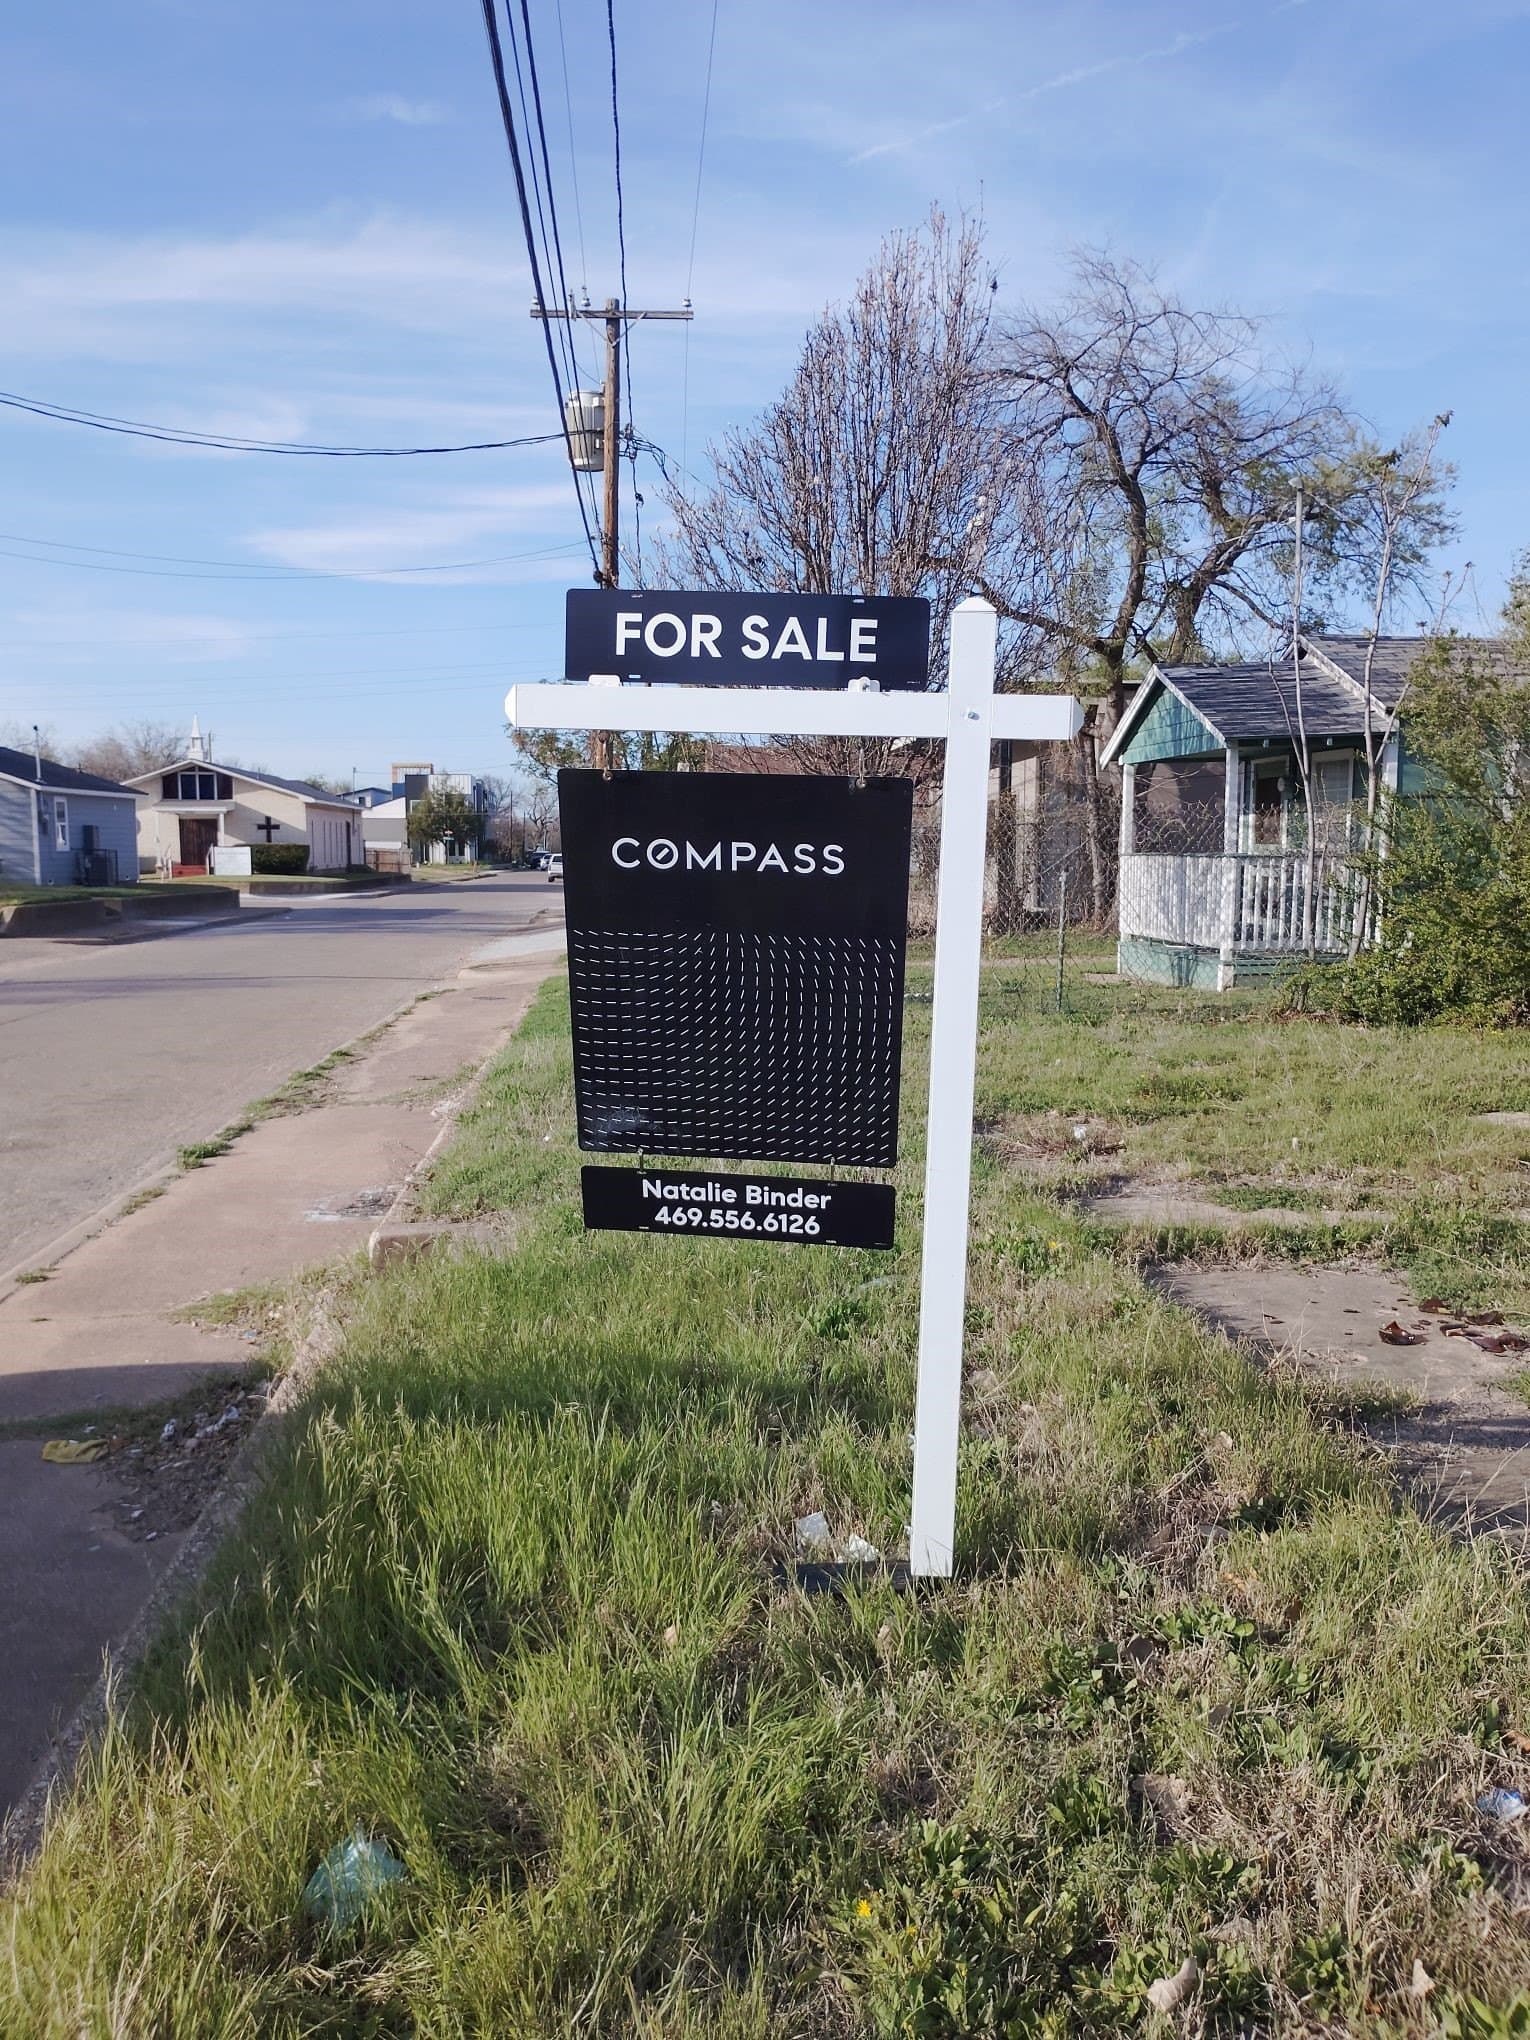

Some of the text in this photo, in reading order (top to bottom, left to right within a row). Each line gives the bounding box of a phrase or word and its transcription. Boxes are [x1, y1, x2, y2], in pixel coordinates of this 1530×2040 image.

[615, 612, 878, 663] FOR SALE
[611, 837, 845, 875] COMPASS
[642, 1178, 832, 1209] Natalie Binder
[654, 1205, 821, 1235] 469.556.6126
